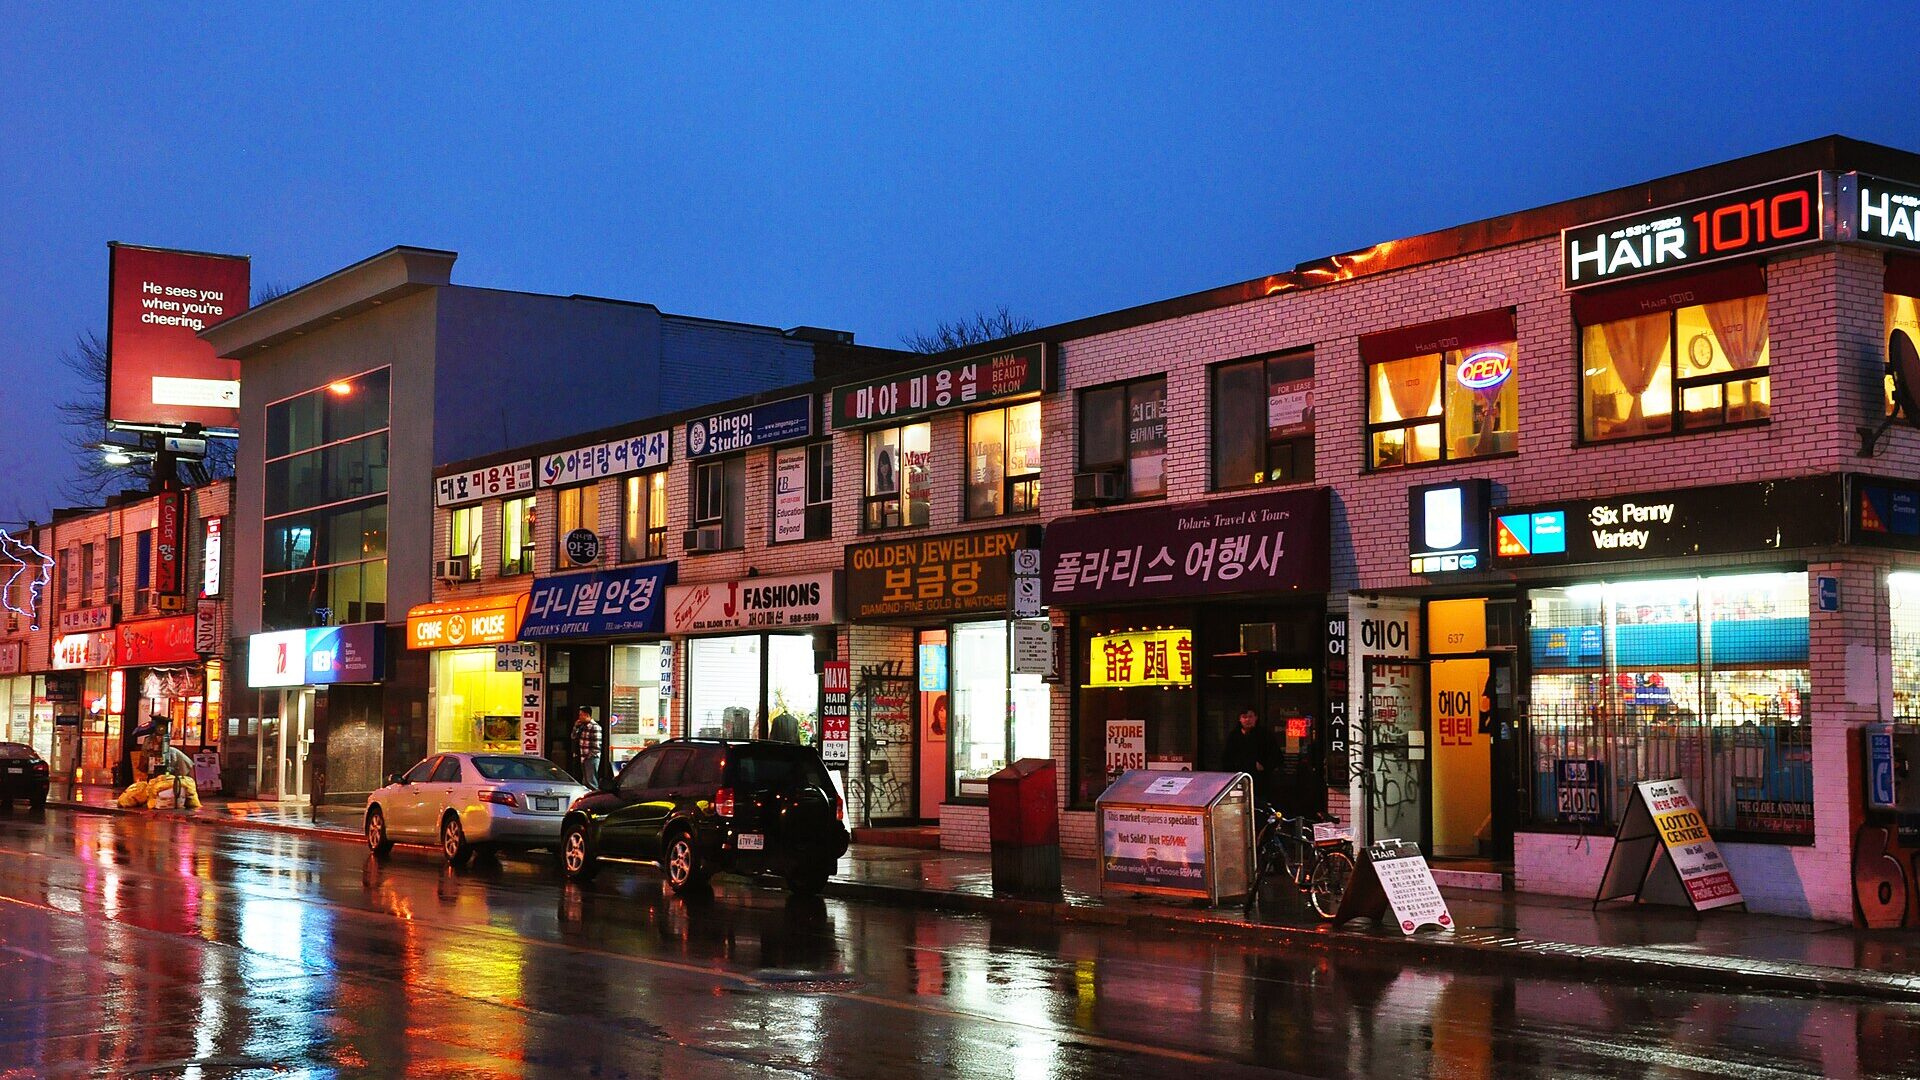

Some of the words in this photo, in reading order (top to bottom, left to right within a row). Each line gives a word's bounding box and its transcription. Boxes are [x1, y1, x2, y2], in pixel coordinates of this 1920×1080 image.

[1571, 228, 1687, 281] HAIR
[1693, 190, 1809, 254] 1010
[143, 281, 162, 294] He
[165, 285, 197, 299] sees
[199, 289, 224, 302] you
[1669, 291, 1694, 304] 1010
[142, 297, 179, 311] when
[182, 302, 223, 315] you're
[141, 312, 205, 331] cheering.
[1438, 337, 1459, 348] 1010
[992, 353, 1016, 368] MAYA
[1463, 357, 1511, 381] OPEN
[992, 364, 1026, 382] BEAUTY
[856, 382, 898, 419] 마야
[910, 363, 977, 409] 미용실
[992, 380, 1021, 396] SALON
[1277, 386, 1290, 394] FOR
[1293, 381, 1311, 391] LEASE
[709, 413, 753, 435] Bingo!
[709, 430, 753, 454] Studio
[1177, 516, 1211, 531] Polaris
[1213, 510, 1245, 527] Travel
[1248, 511, 1257, 523] &
[1260, 507, 1290, 522] Tours
[1591, 506, 1619, 526] Six
[1622, 503, 1675, 523] Penny
[779, 524, 801, 535] Beyond
[1592, 528, 1649, 550] Variety
[568, 541, 596, 557] 안경
[853, 543, 916, 570] GOLDEN
[921, 532, 1020, 566] JEWELLERY
[1052, 545, 1176, 593] 폴라리스
[1184, 531, 1285, 582] 여행사
[882, 561, 982, 602] 보금당
[530, 581, 604, 619] 다니엘
[602, 576, 657, 615] 안경
[743, 582, 820, 611] FASHIONS
[904, 601, 923, 612] FINE
[927, 598, 951, 610] GOLD
[417, 620, 442, 640] CAKE
[471, 614, 505, 636] HOUSE
[561, 621, 590, 634] OPTICAL
[707, 620, 723, 629] BLOOR
[1329, 620, 1345, 656] 헤어
[1362, 619, 1410, 651] 헤어
[1448, 633, 1464, 644] 637
[498, 644, 537, 657] 아리랑
[498, 659, 538, 672] 여행사
[825, 667, 848, 689] MAYA
[826, 693, 846, 703] HAIR
[1439, 690, 1471, 716] 헤어
[824, 705, 847, 716] SALON
[827, 719, 845, 728] マヤ
[1108, 725, 1143, 738] STORE
[1331, 702, 1344, 752] HAIR
[1439, 717, 1472, 746] 텐텐
[825, 730, 848, 739] 美容室
[1107, 752, 1143, 770] LEASE
[1650, 786, 1668, 798] Come
[1108, 811, 1118, 822] This
[1119, 813, 1140, 823] market
[1168, 814, 1199, 827] specialist.
[1659, 812, 1700, 831] LOTTO
[1118, 833, 1129, 844] Not
[1130, 833, 1147, 845] Sold?
[1149, 834, 1160, 846] Not
[1667, 827, 1707, 843] CENTRE
[1370, 849, 1397, 860] HAIR
[1107, 862, 1128, 873] Choose
